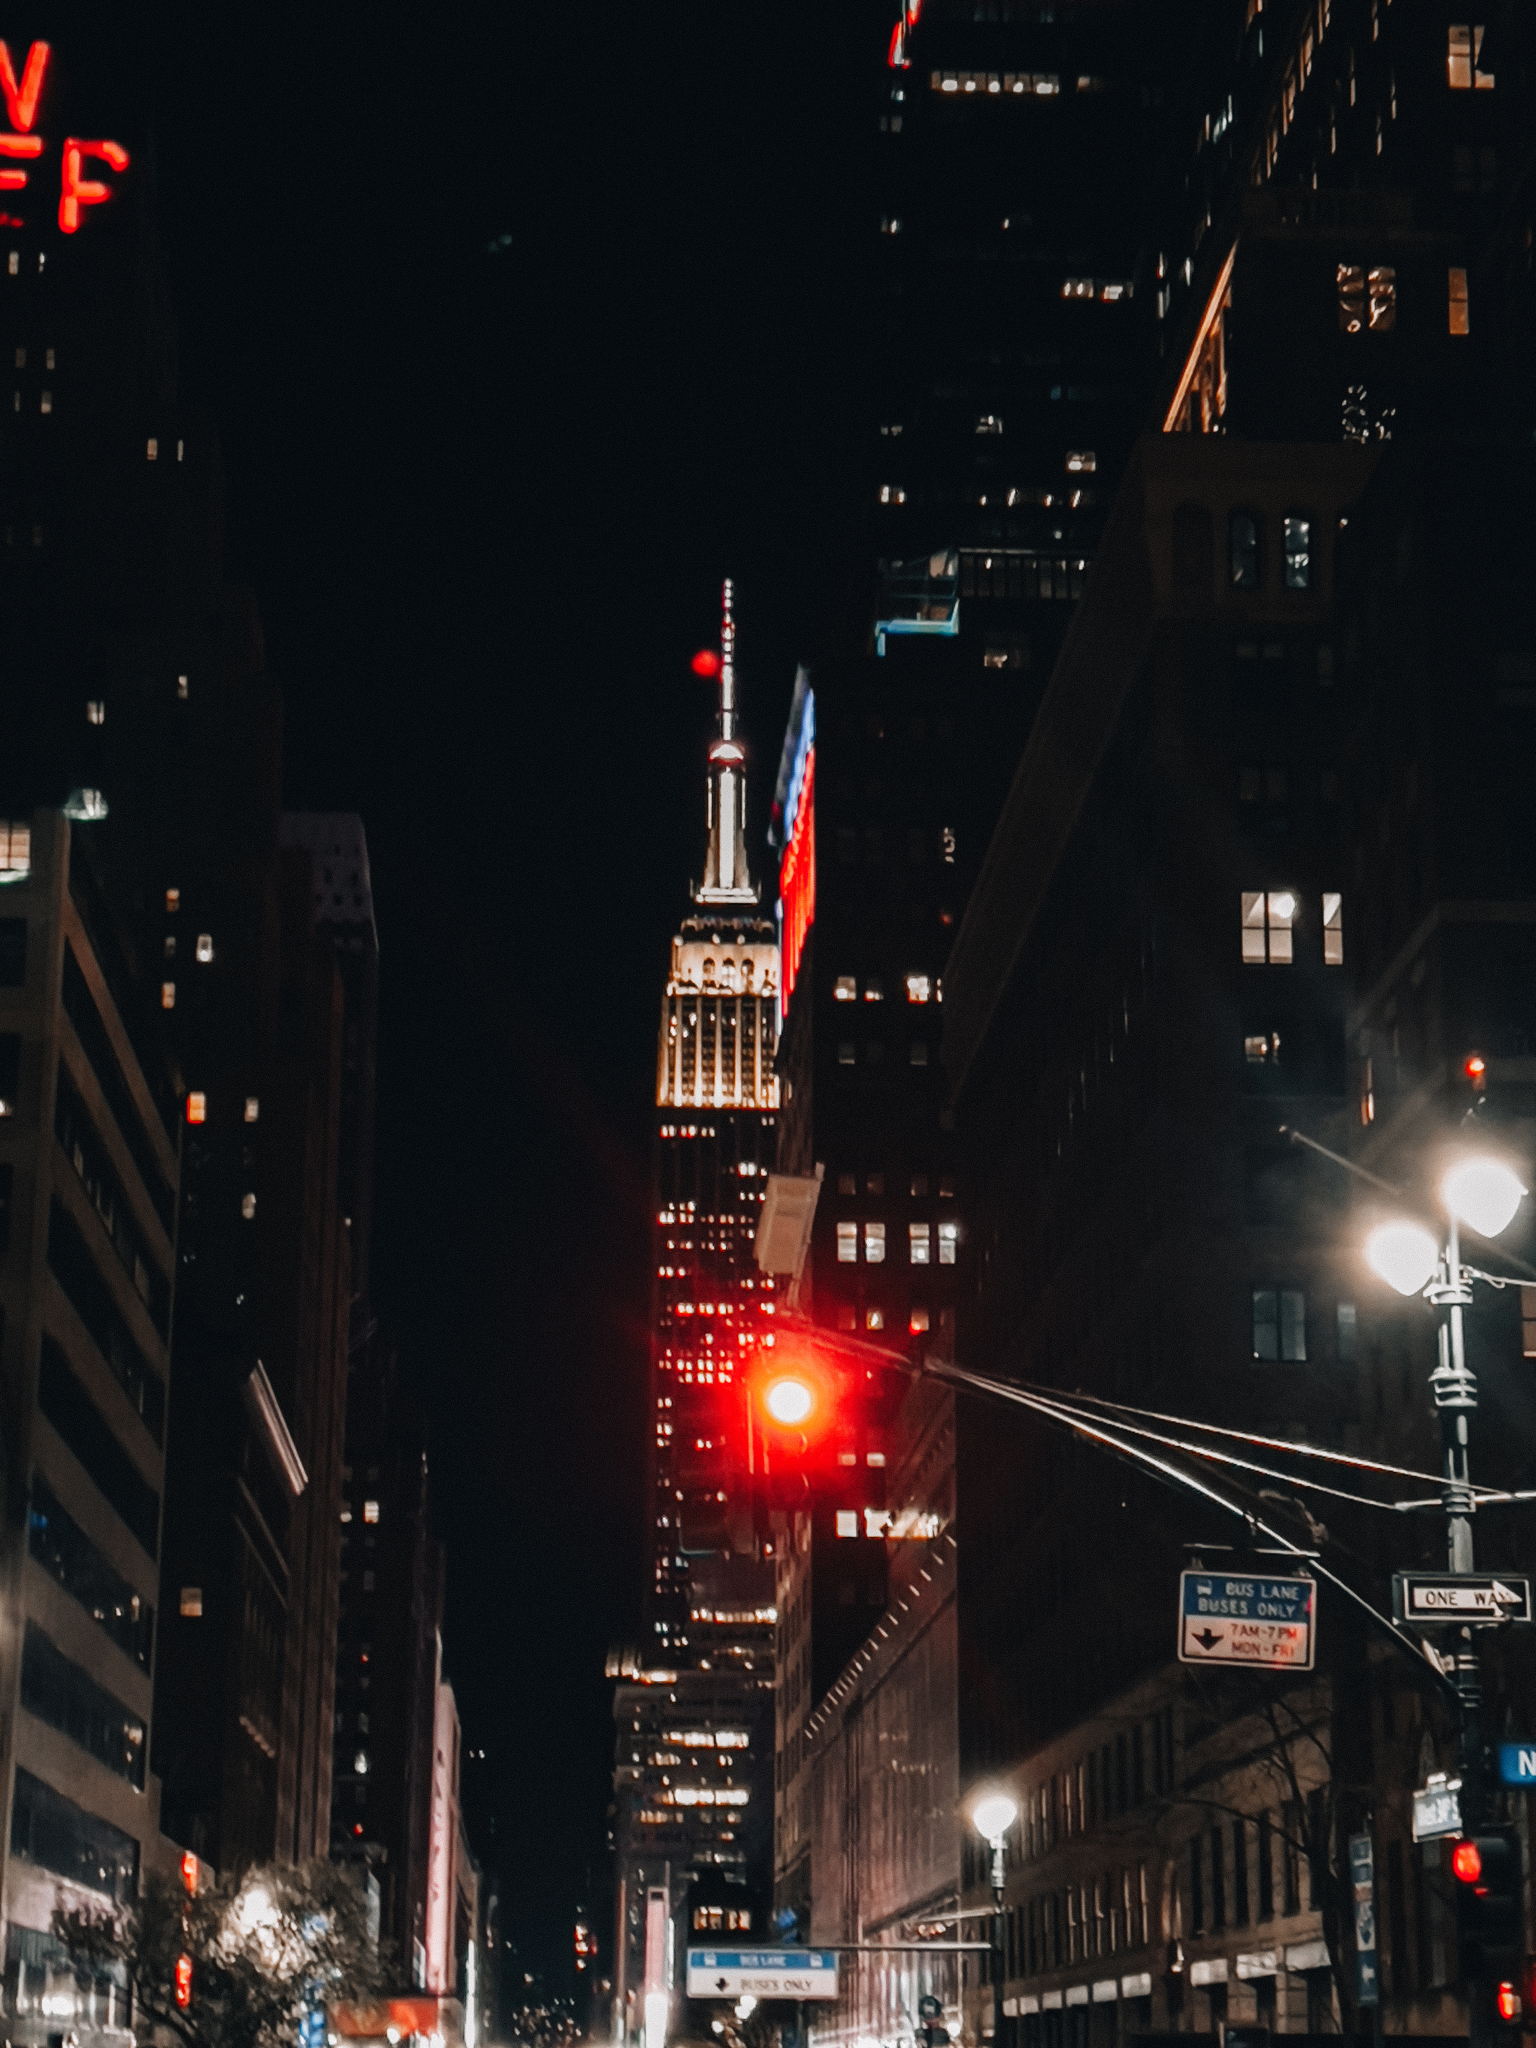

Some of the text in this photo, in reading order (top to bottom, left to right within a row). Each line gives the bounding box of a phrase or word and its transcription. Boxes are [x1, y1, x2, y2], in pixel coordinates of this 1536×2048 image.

[1225, 1582, 1299, 1600] BUS LANE
[1425, 1591, 1513, 1606] ONE WAY
[1198, 1598, 1297, 1618] BUSES ONLY
[784, 1979, 812, 1991] ONLY
